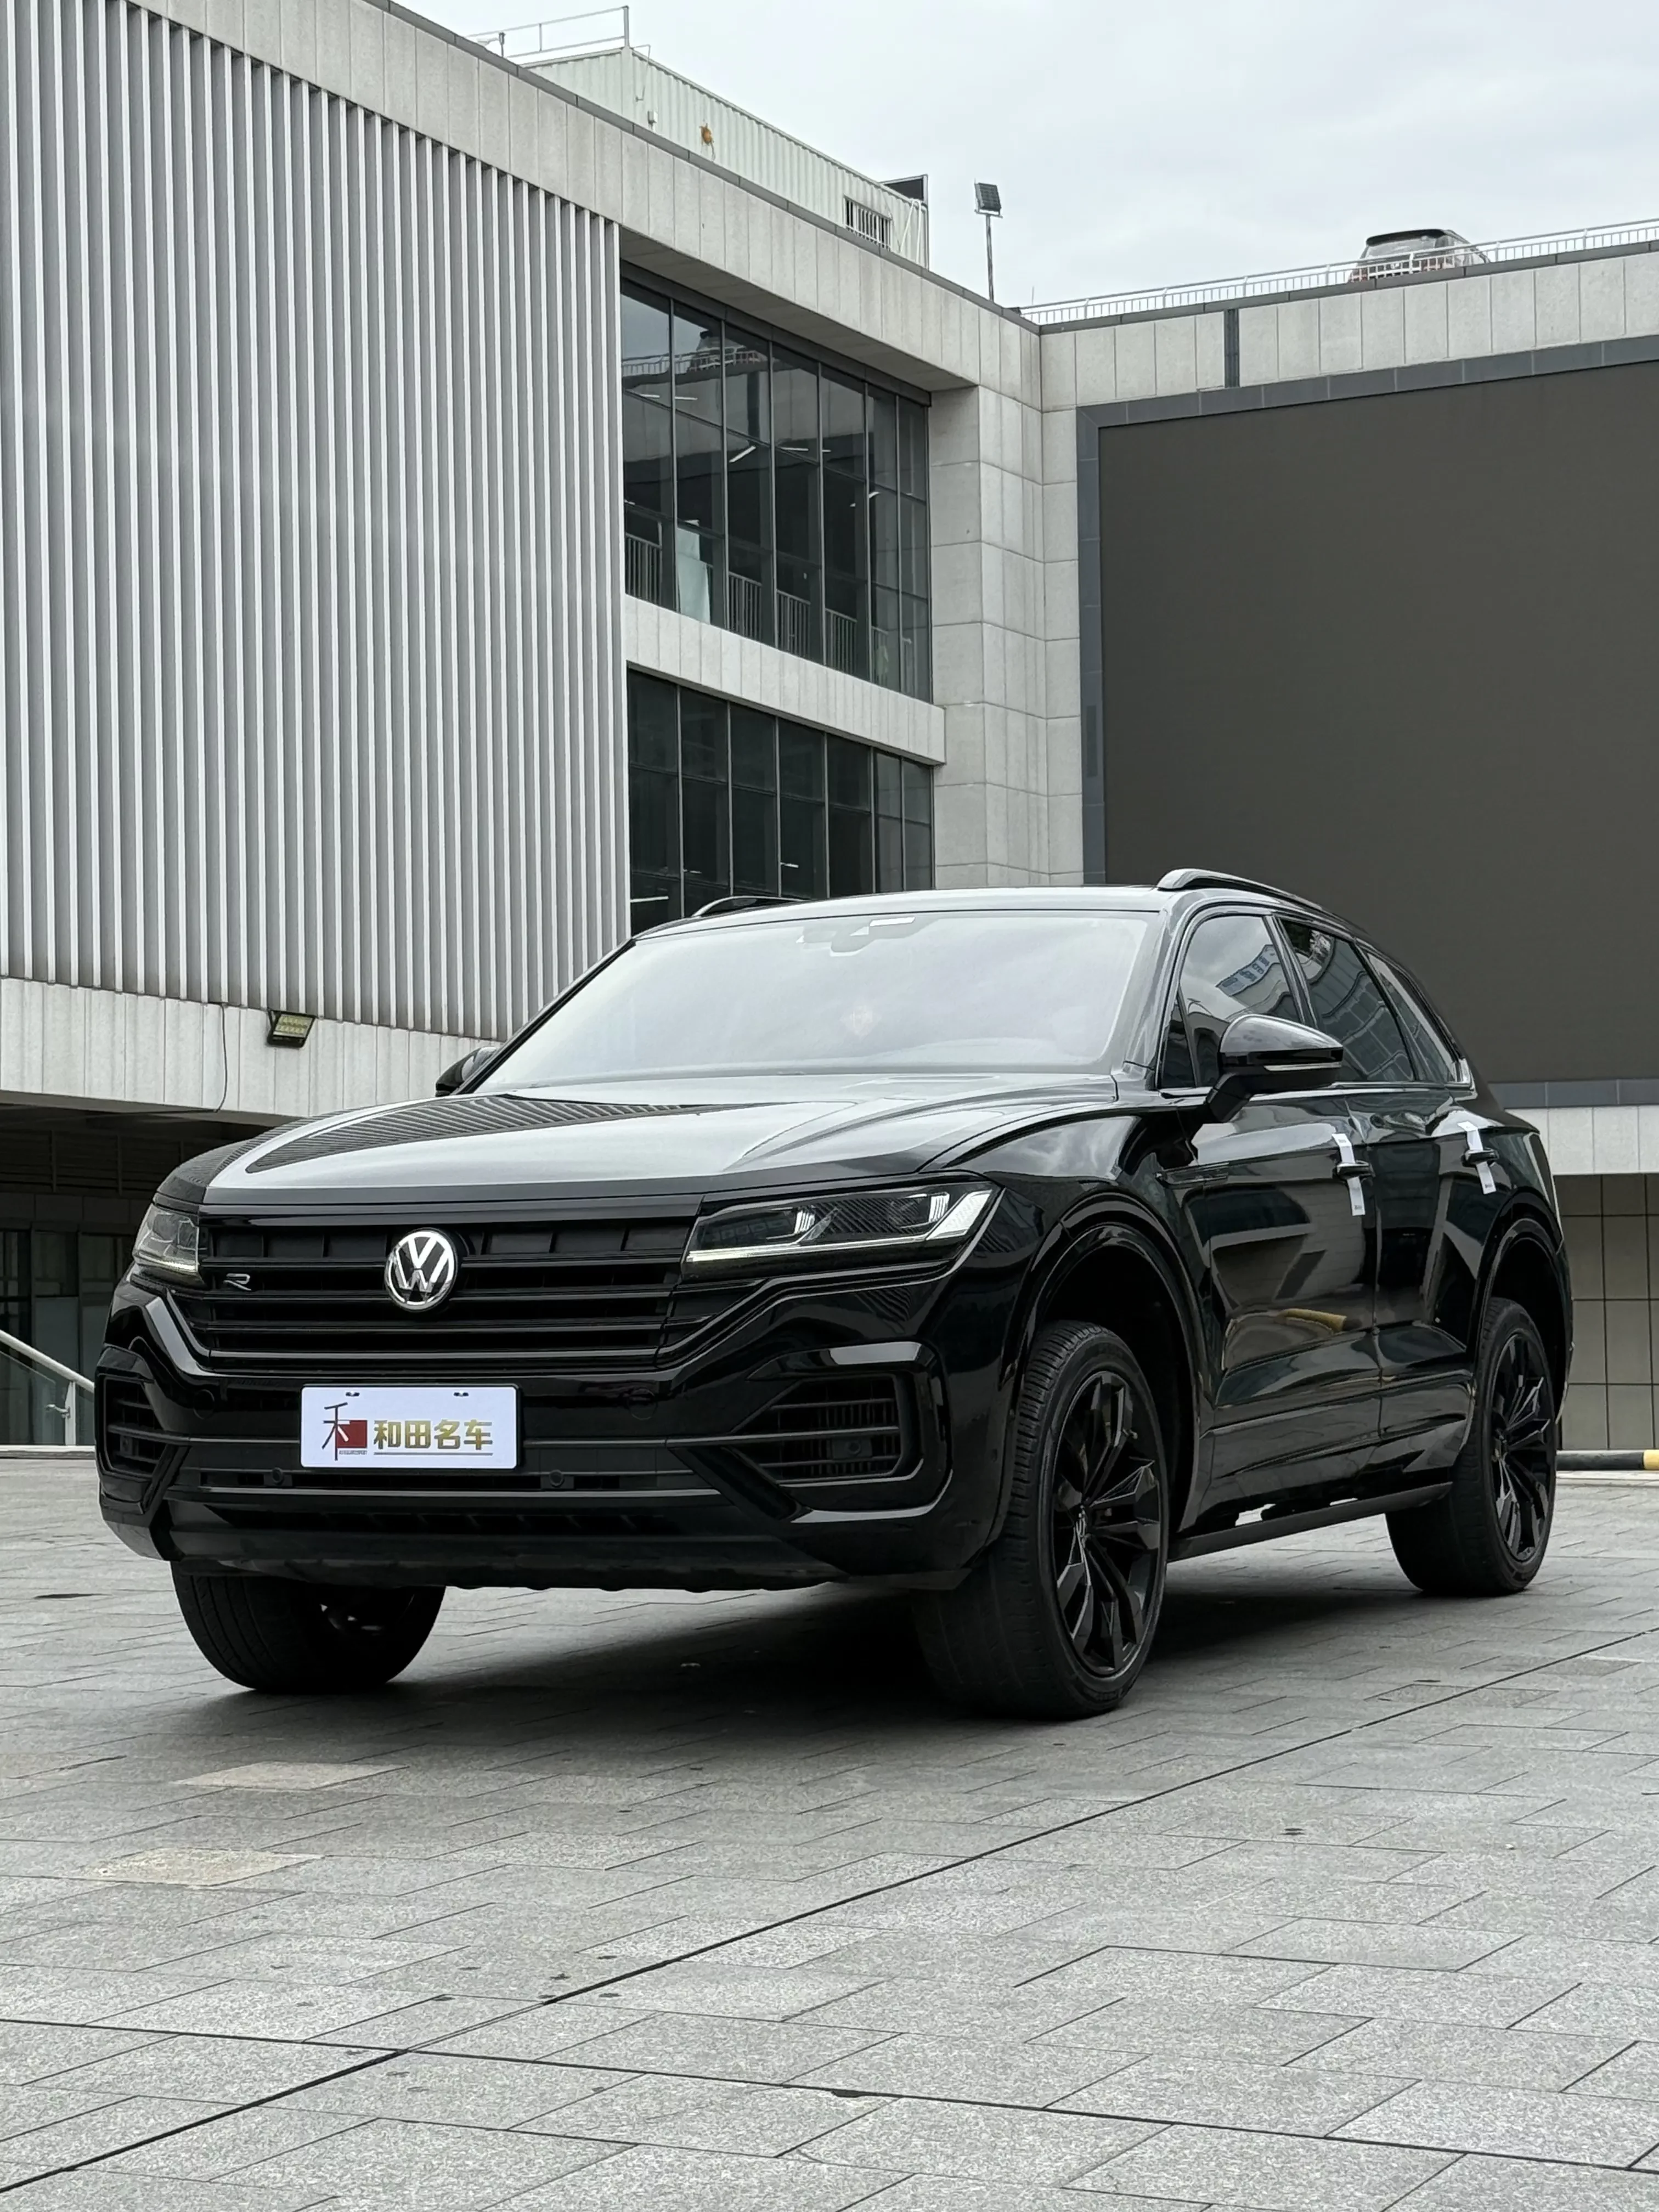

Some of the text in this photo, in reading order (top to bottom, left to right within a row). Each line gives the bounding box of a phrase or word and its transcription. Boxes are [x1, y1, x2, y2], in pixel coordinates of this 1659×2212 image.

[223, 1273, 252, 1291] R
[374, 1419, 493, 1450] 和田名车
